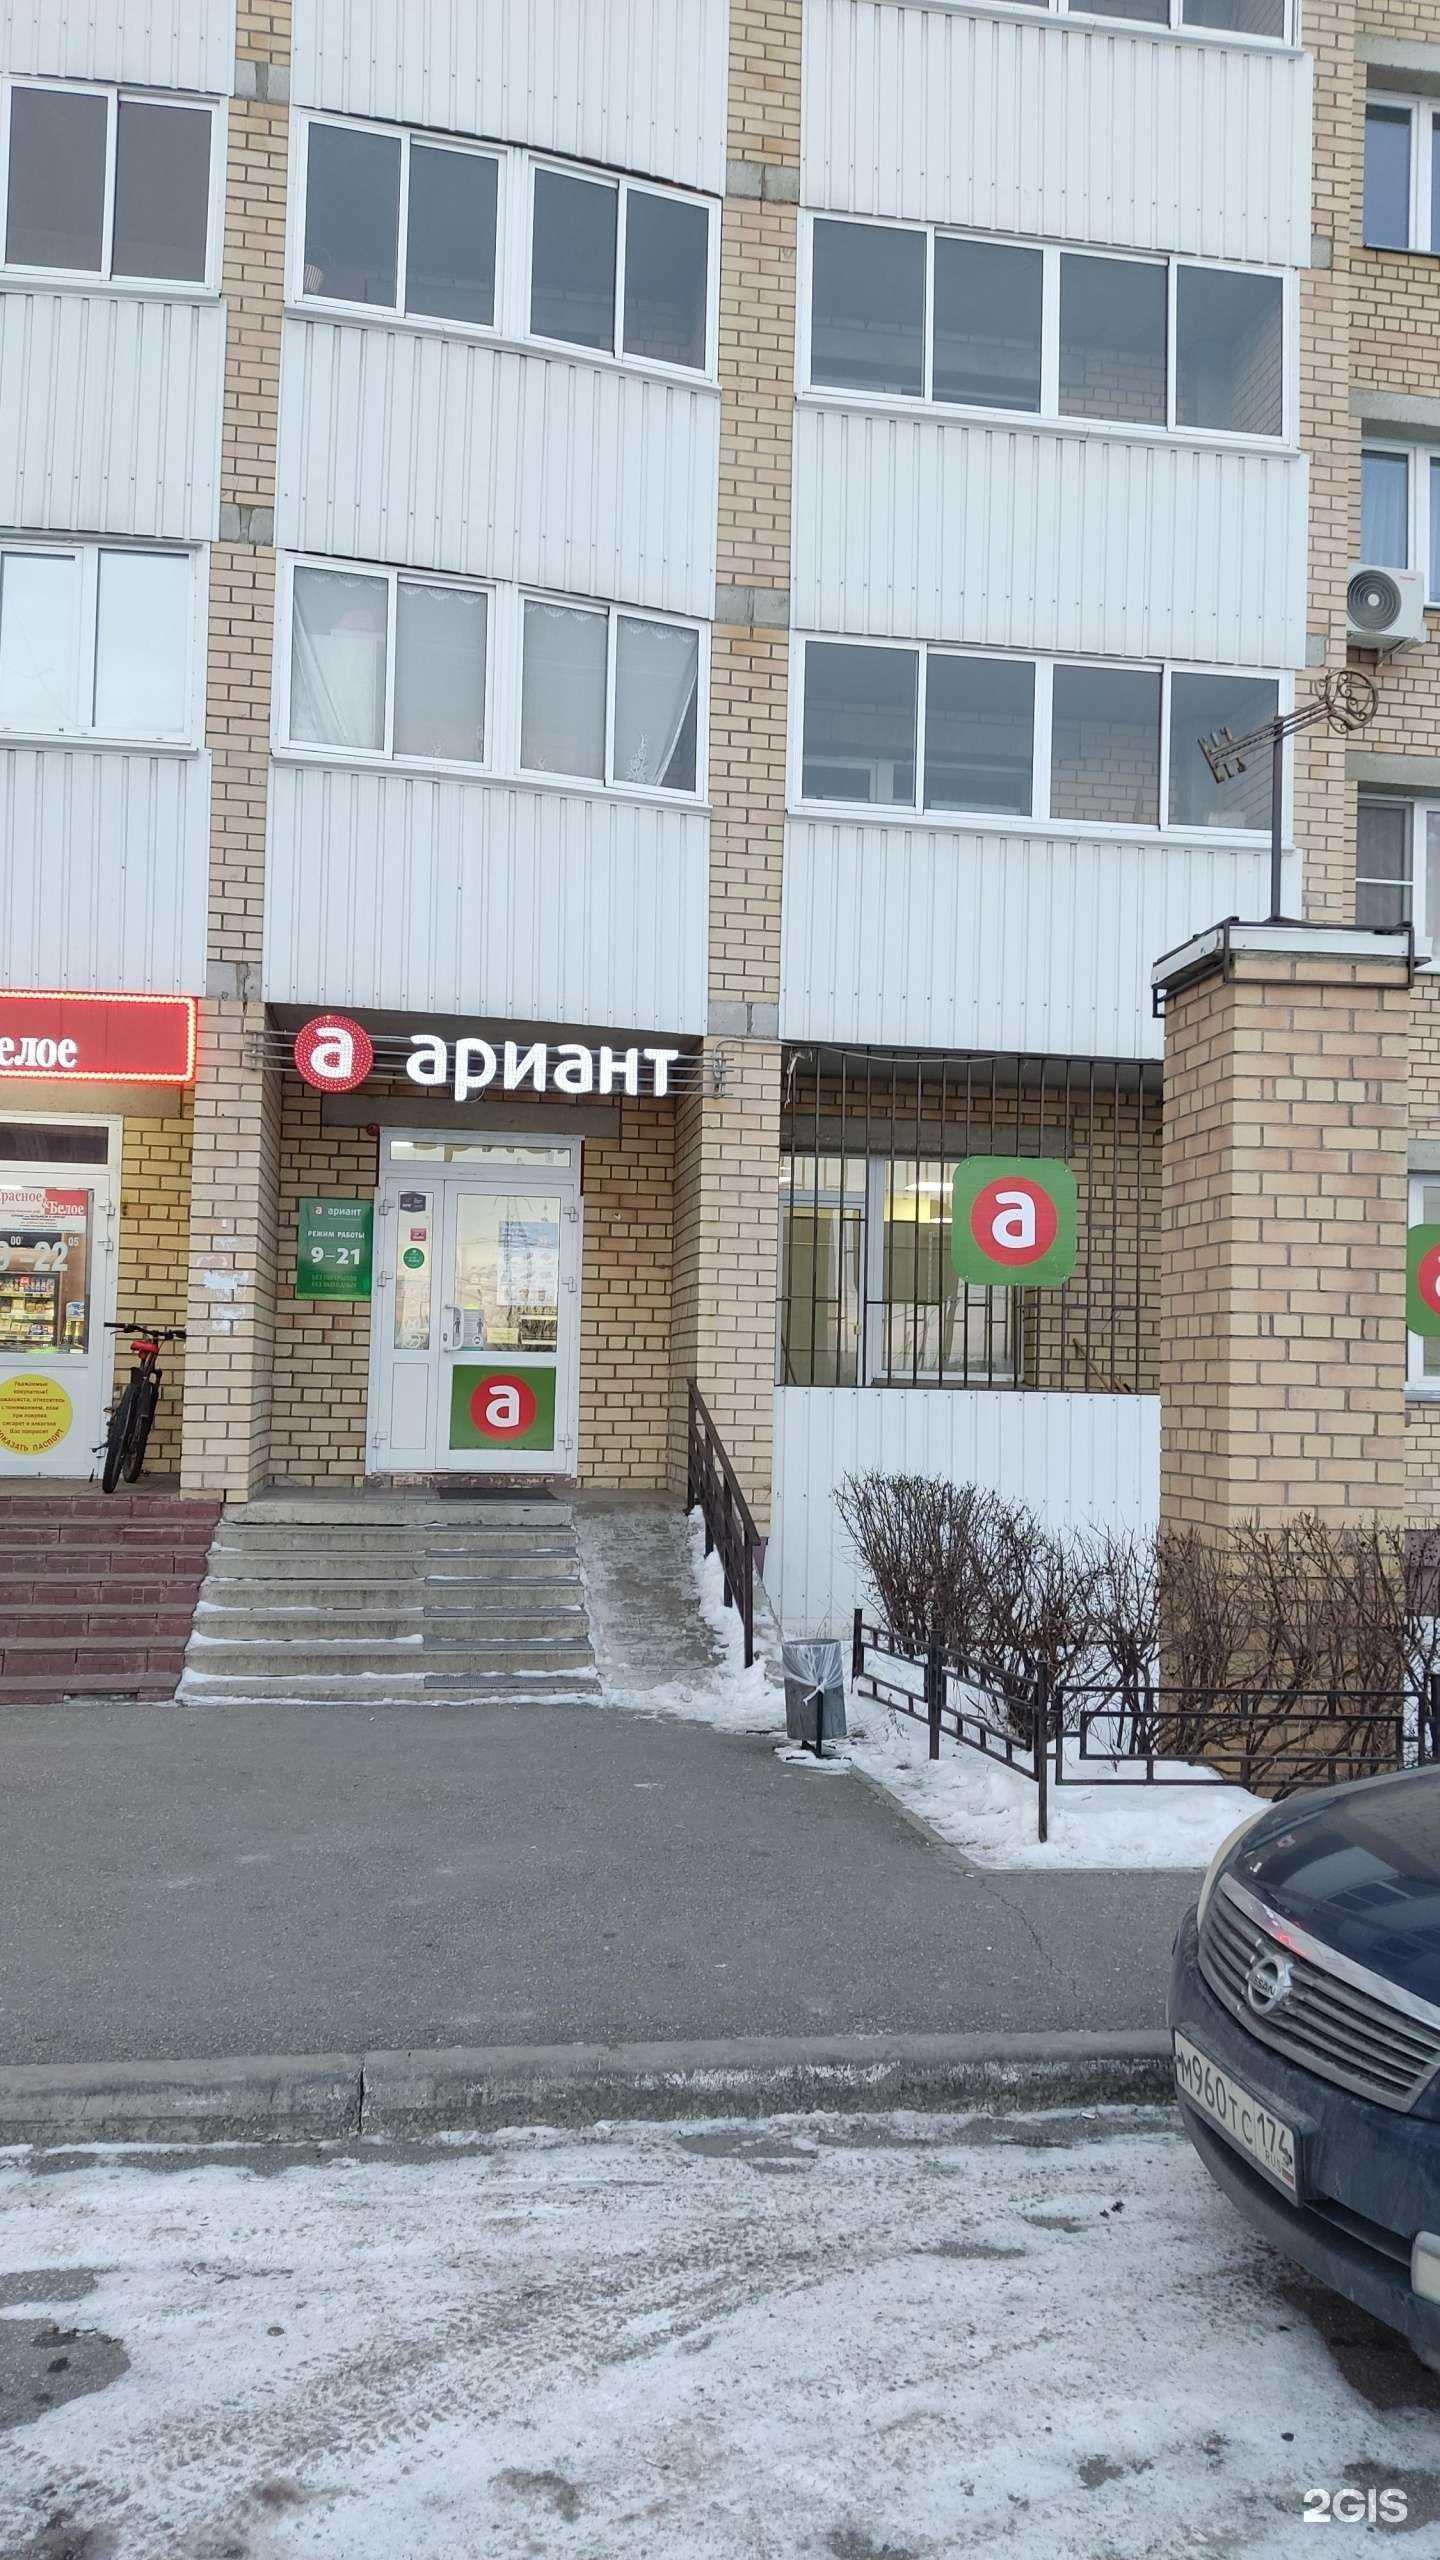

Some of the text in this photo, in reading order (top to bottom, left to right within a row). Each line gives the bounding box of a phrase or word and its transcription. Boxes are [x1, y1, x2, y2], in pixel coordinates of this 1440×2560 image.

[310, 1027, 679, 1101] а ариант
[0, 1191, 42, 1204] расное
[49, 1201, 85, 1214] Белое
[327, 1207, 362, 1216] ариант
[992, 1191, 1036, 1249] а
[307, 1230, 365, 1239] РЕЖИМ РАБОТЫ
[486, 1385, 520, 1428] а
[0, 1428, 64, 1451] ОКАЗАТЬ ПАСПОРТ
